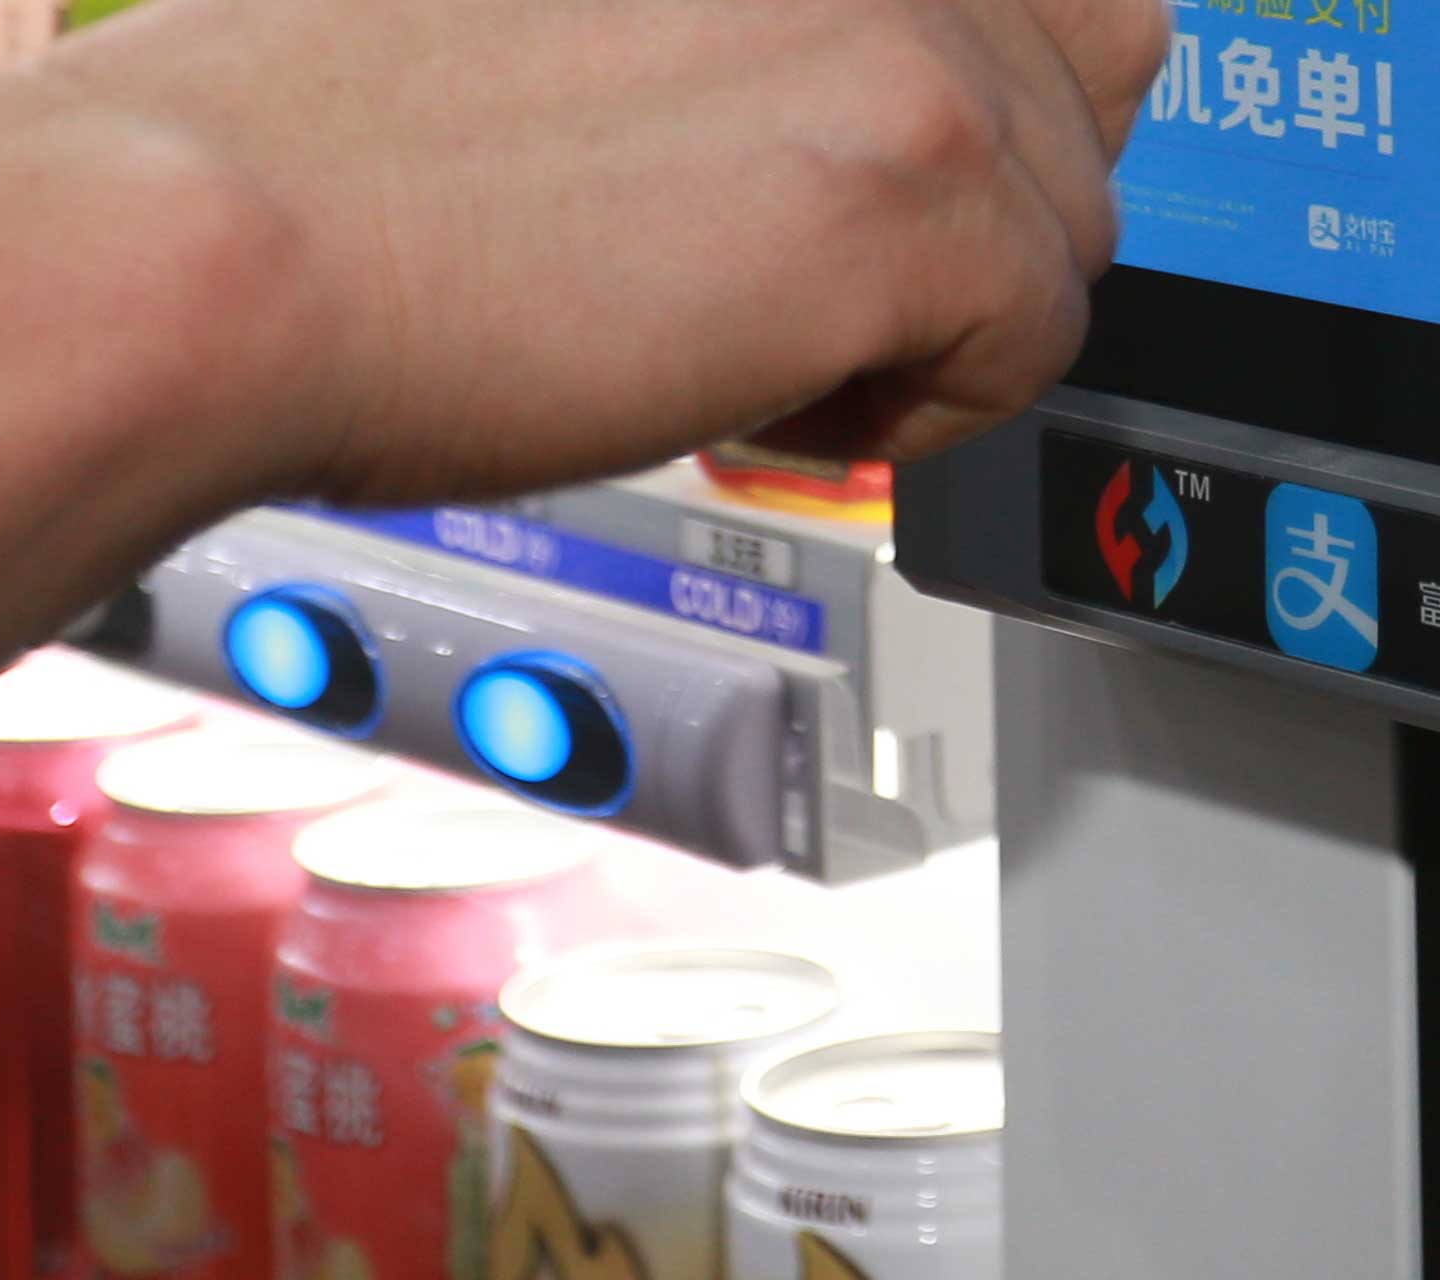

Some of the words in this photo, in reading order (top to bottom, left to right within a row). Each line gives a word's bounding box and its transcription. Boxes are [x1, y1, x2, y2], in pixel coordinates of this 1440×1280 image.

[1343, 213, 1396, 245] 支付宝
[1175, 469, 1211, 502] TM
